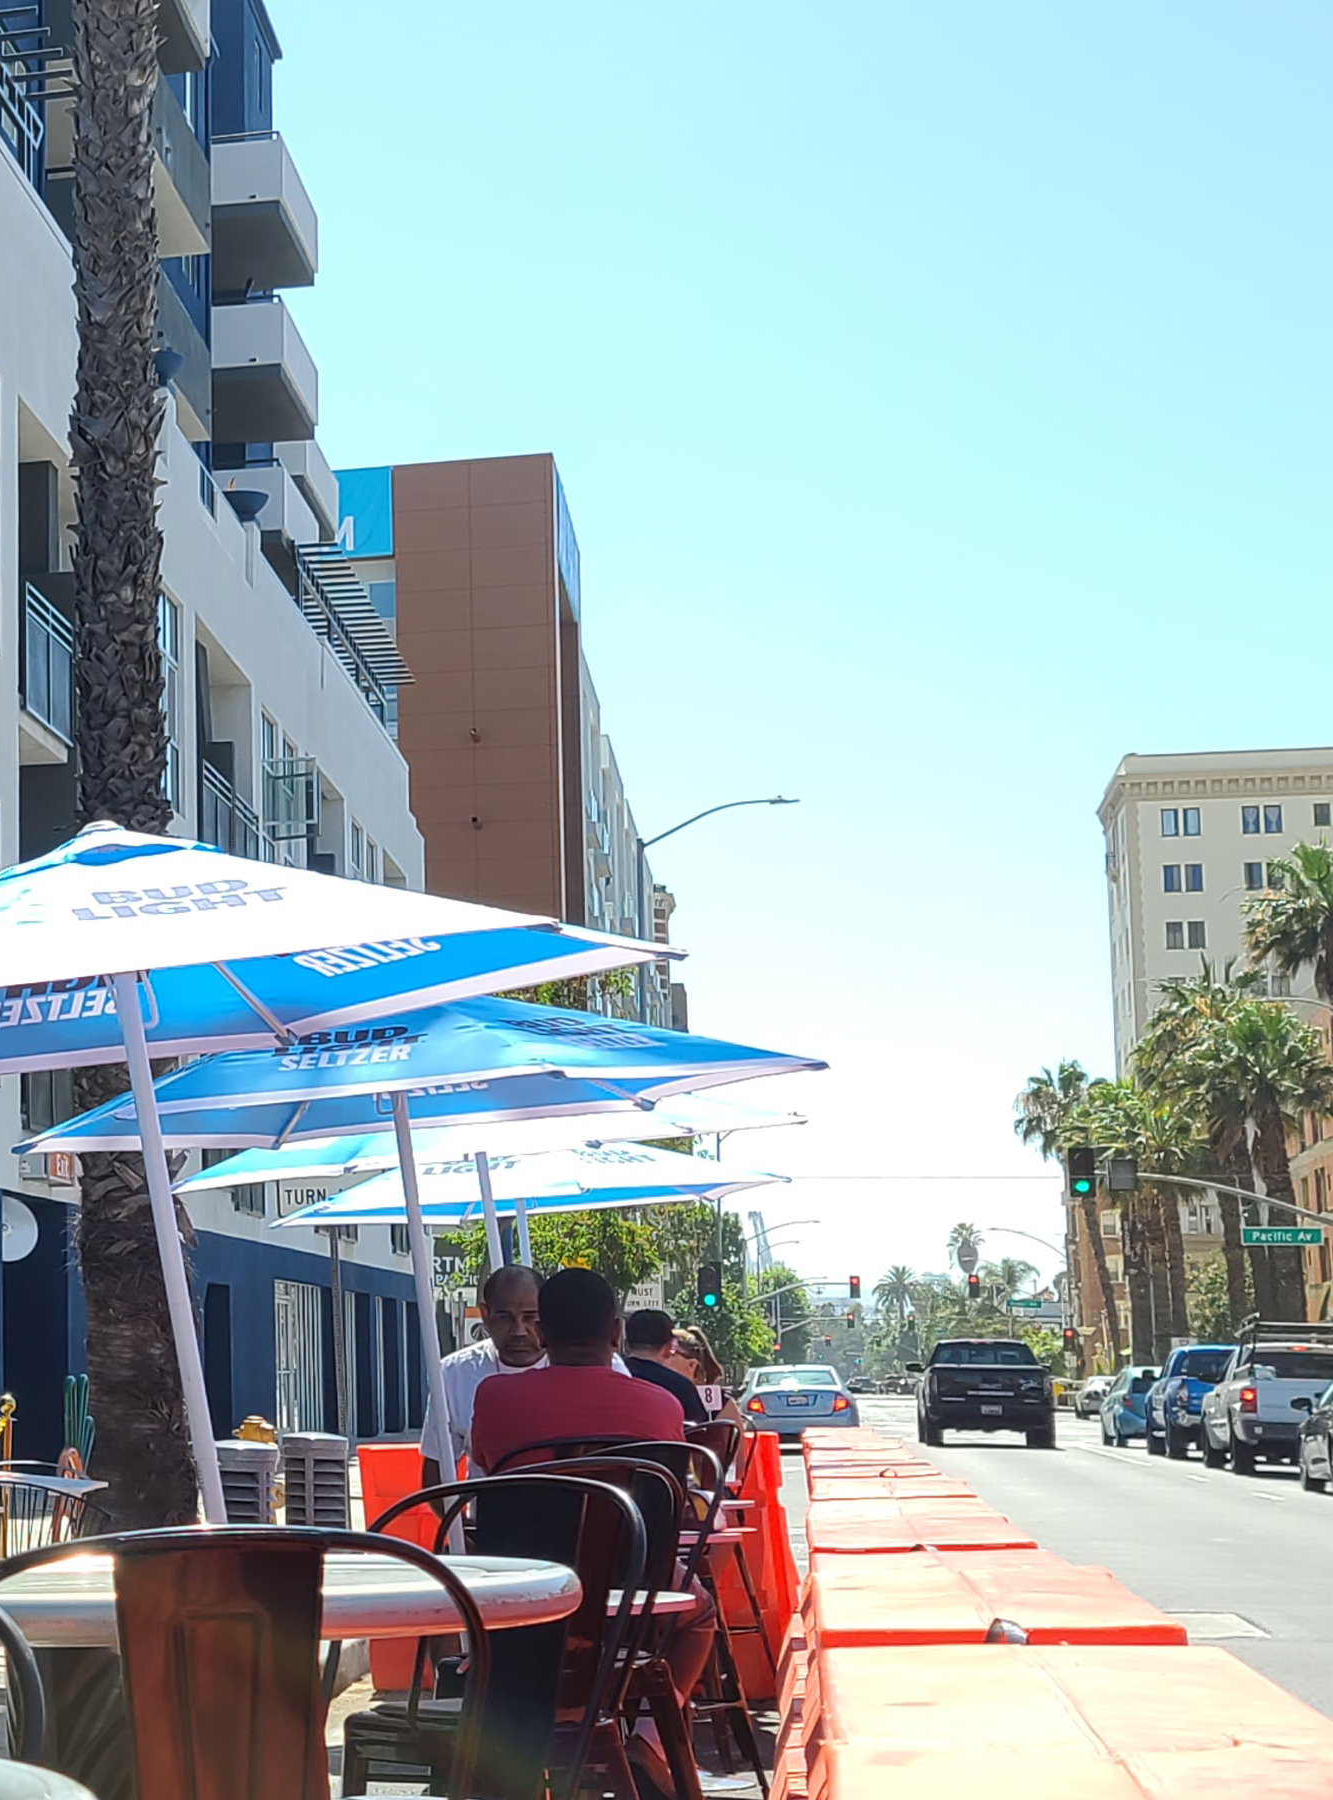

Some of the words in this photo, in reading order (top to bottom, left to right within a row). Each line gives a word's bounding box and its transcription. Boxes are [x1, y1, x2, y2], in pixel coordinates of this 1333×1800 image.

[91, 879, 249, 905] BUD
[71, 886, 288, 920] LIGHT
[297, 1026, 409, 1046] BUD
[277, 1045, 412, 1071] SELTZER
[284, 1188, 327, 1205] TURN
[1252, 1231, 1293, 1242] Pacific
[1297, 1230, 1312, 1242] Av
[704, 1387, 713, 1403] 8
